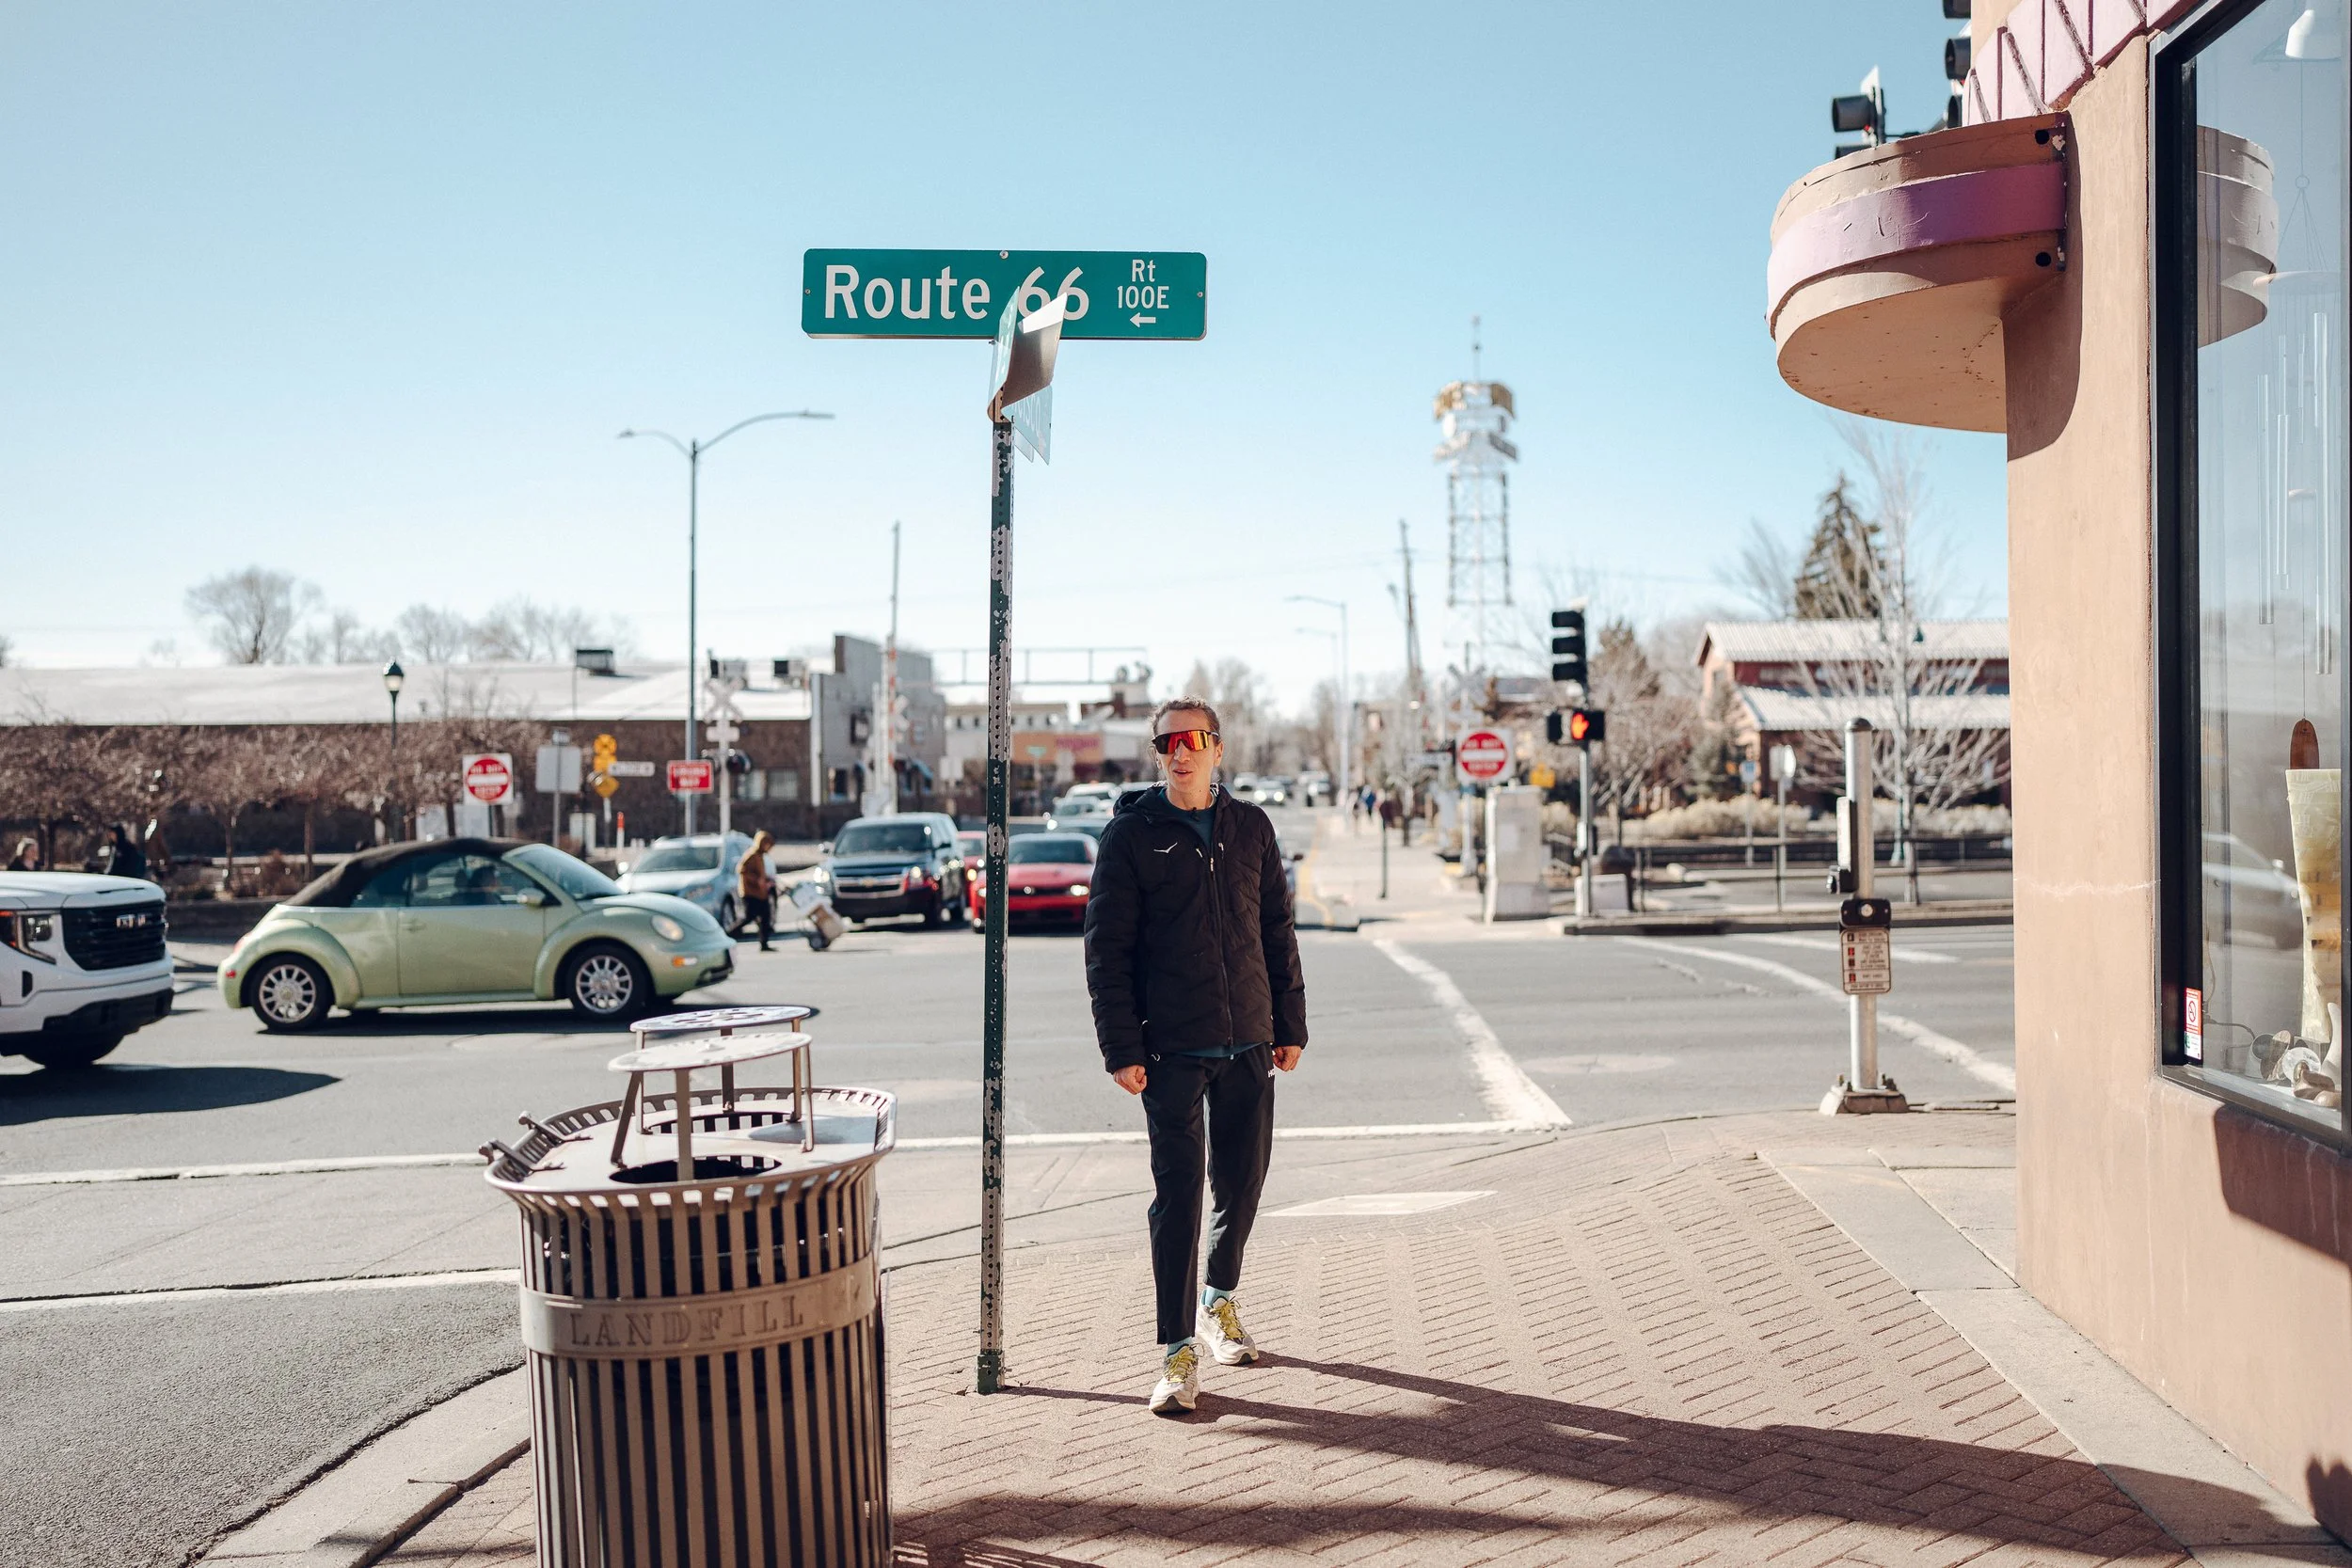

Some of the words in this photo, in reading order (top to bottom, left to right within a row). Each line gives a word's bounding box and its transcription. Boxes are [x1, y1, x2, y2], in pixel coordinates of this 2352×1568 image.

[1132, 259, 1156, 282] Rt
[824, 264, 991, 320] Route
[1017, 266, 1089, 321] 66
[1117, 285, 1169, 309] 100E
[569, 1295, 803, 1346] LANDFILL
